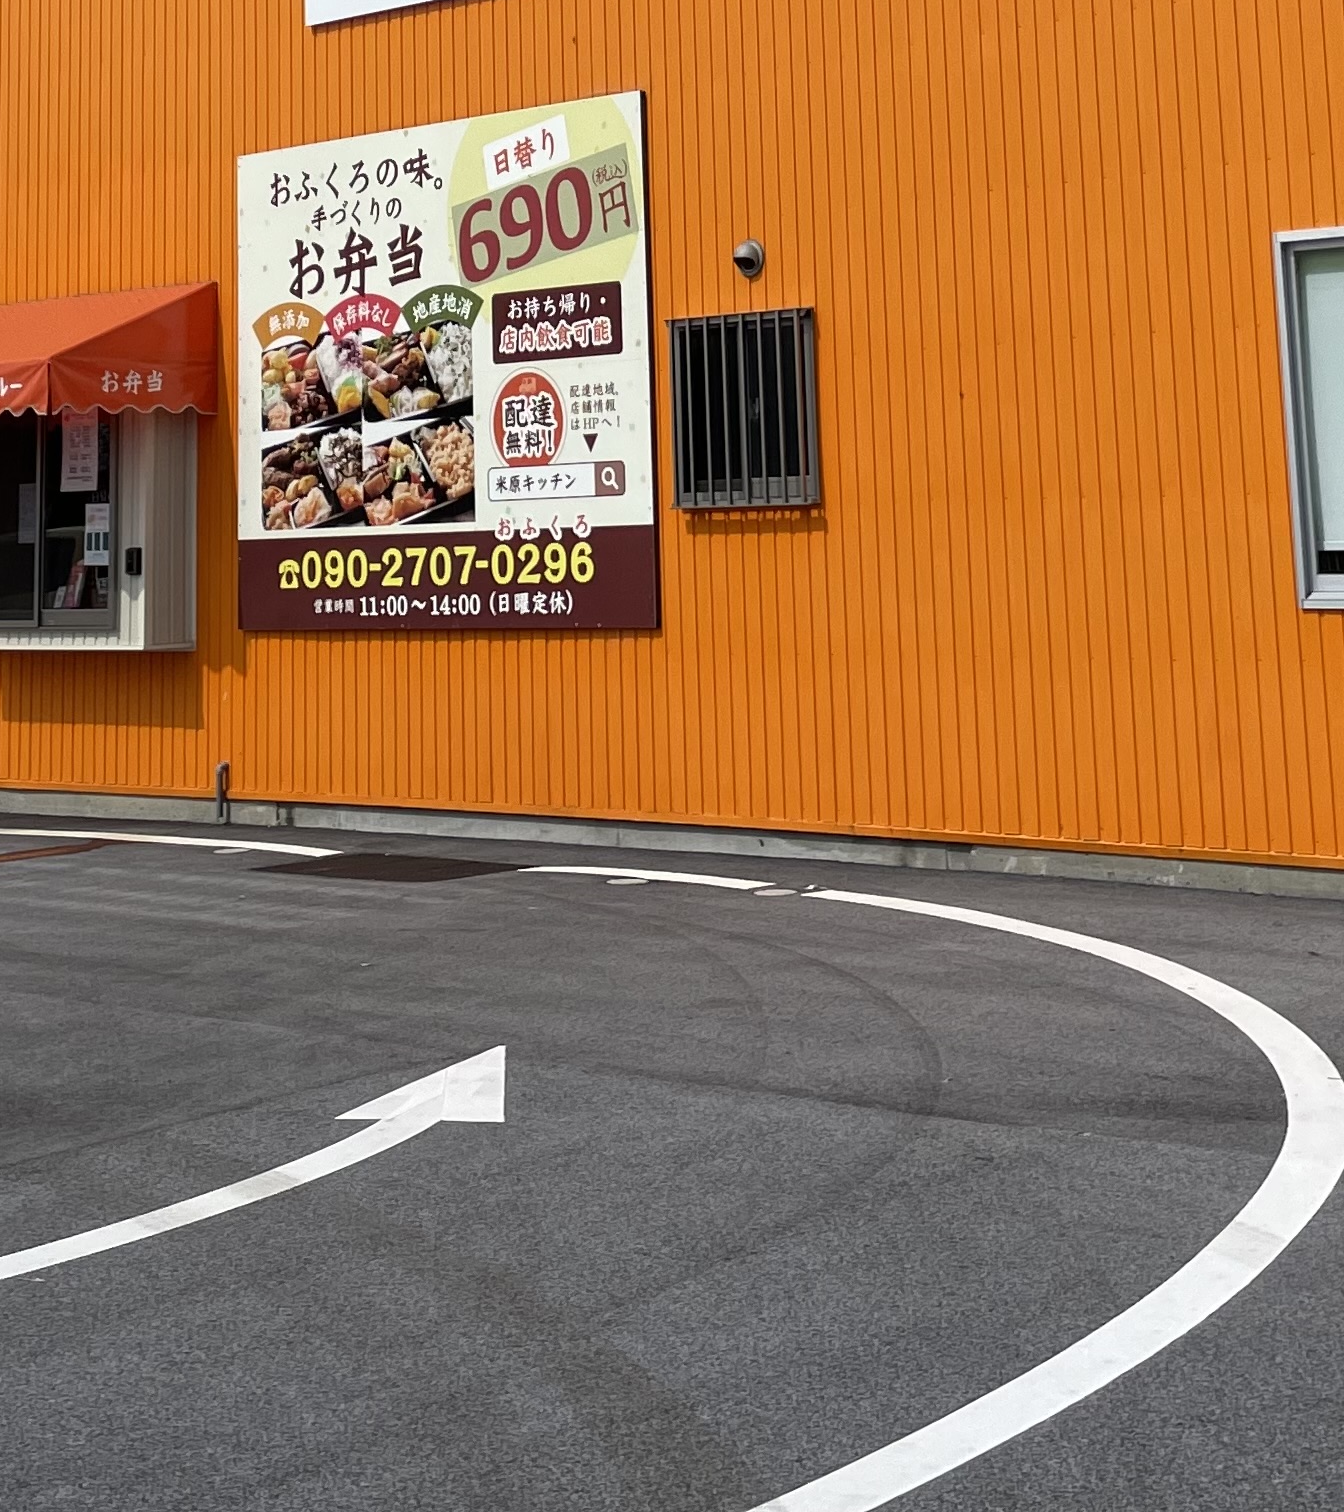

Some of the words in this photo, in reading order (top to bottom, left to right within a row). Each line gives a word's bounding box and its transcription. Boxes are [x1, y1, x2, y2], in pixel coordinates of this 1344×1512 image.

[494, 128, 556, 176] 日替り
[270, 148, 444, 207] おふくろの味。
[311, 196, 403, 232] 手づくりの
[289, 223, 424, 299] お弁当
[268, 310, 311, 335] 無添加
[332, 300, 393, 335] 保存料なし
[412, 292, 474, 324] 地産地消
[499, 316, 613, 353] 店内飲食可能
[101, 369, 164, 395] お弁当
[505, 394, 555, 428] 配達
[495, 473, 576, 494] 米原キッチン
[497, 514, 589, 537] おふくろ
[301, 541, 595, 589] 090-2707-0296
[313, 598, 355, 615] 営業時間
